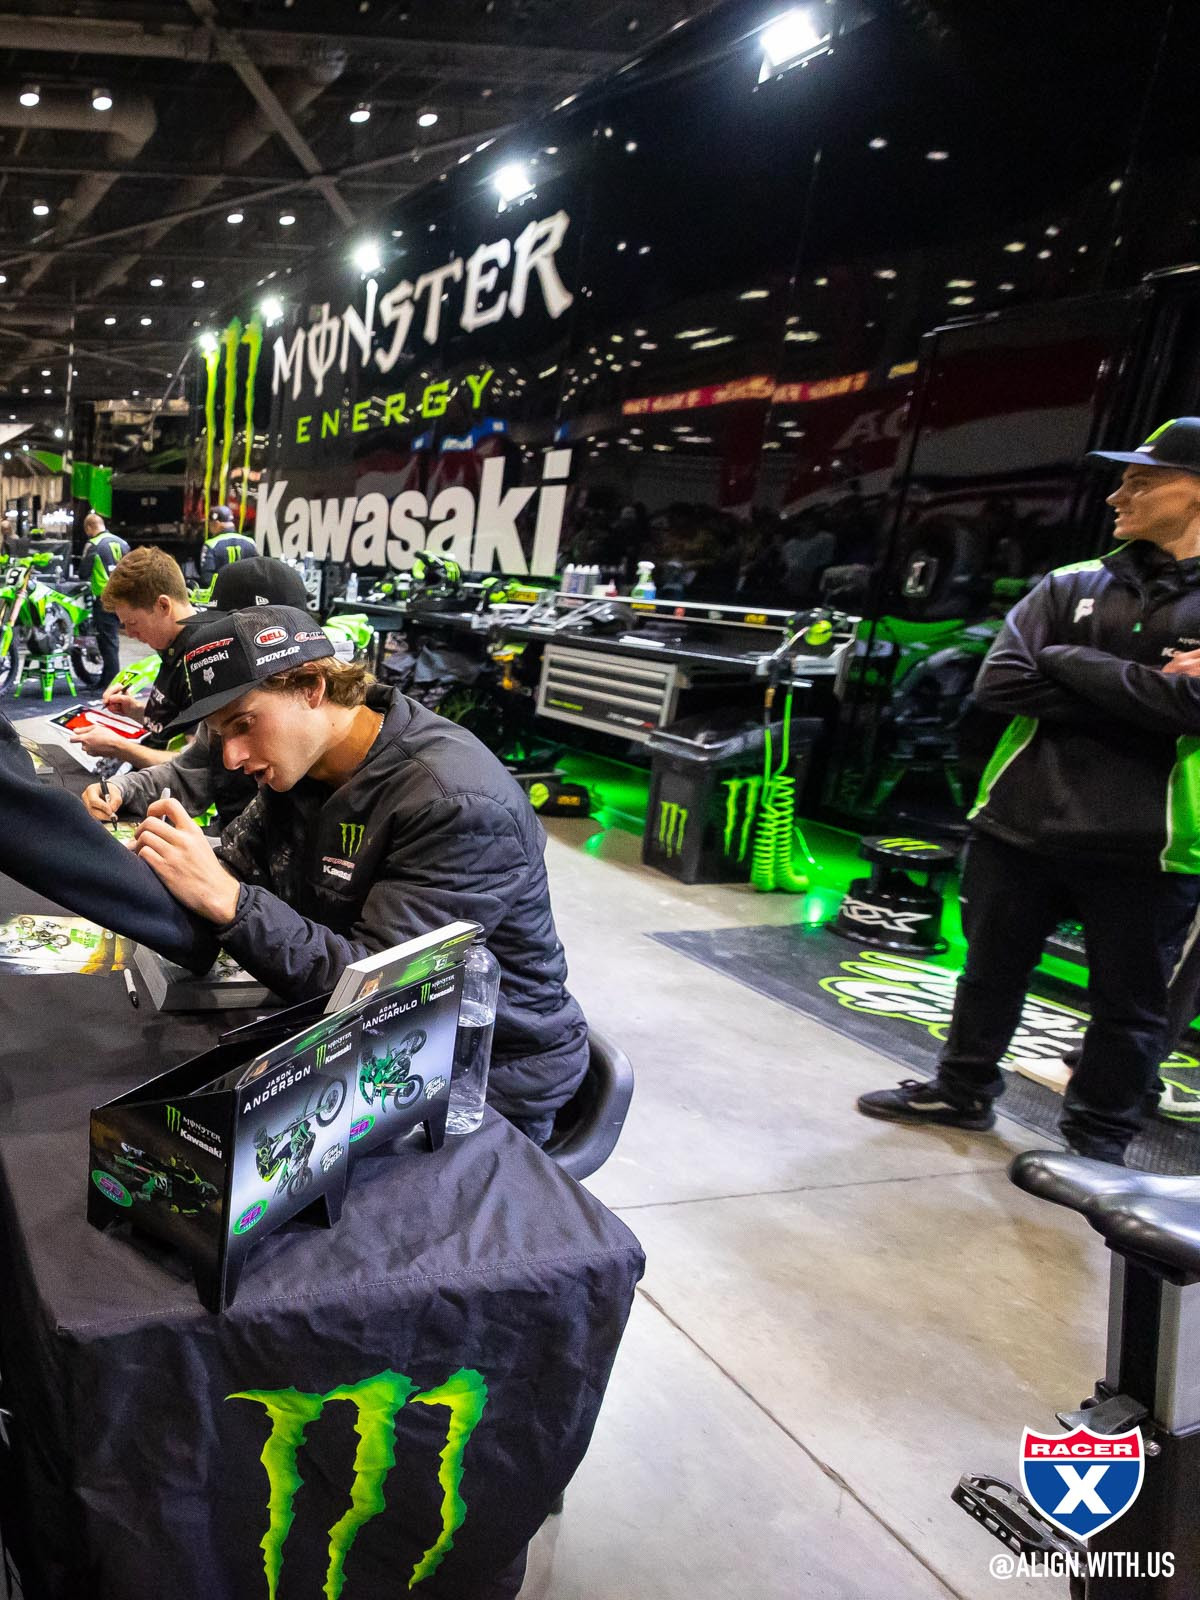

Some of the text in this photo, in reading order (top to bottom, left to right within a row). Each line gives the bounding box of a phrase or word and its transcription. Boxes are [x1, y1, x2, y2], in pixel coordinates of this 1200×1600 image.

[271, 209, 573, 400] MONSTER
[296, 369, 494, 443] ENERGY
[254, 448, 573, 577] Kawasaki
[259, 631, 285, 644] BELL
[190, 649, 229, 673] Kawasaki
[256, 645, 301, 667] DUNLOP
[362, 999, 418, 1030] IANCIARULO
[379, 1002, 398, 1014] ADAM
[243, 1066, 311, 1114] ANDERSON
[266, 1070, 291, 1089] JASON
[180, 1128, 222, 1159] Kawasaki
[183, 1116, 222, 1143] MONSTER
